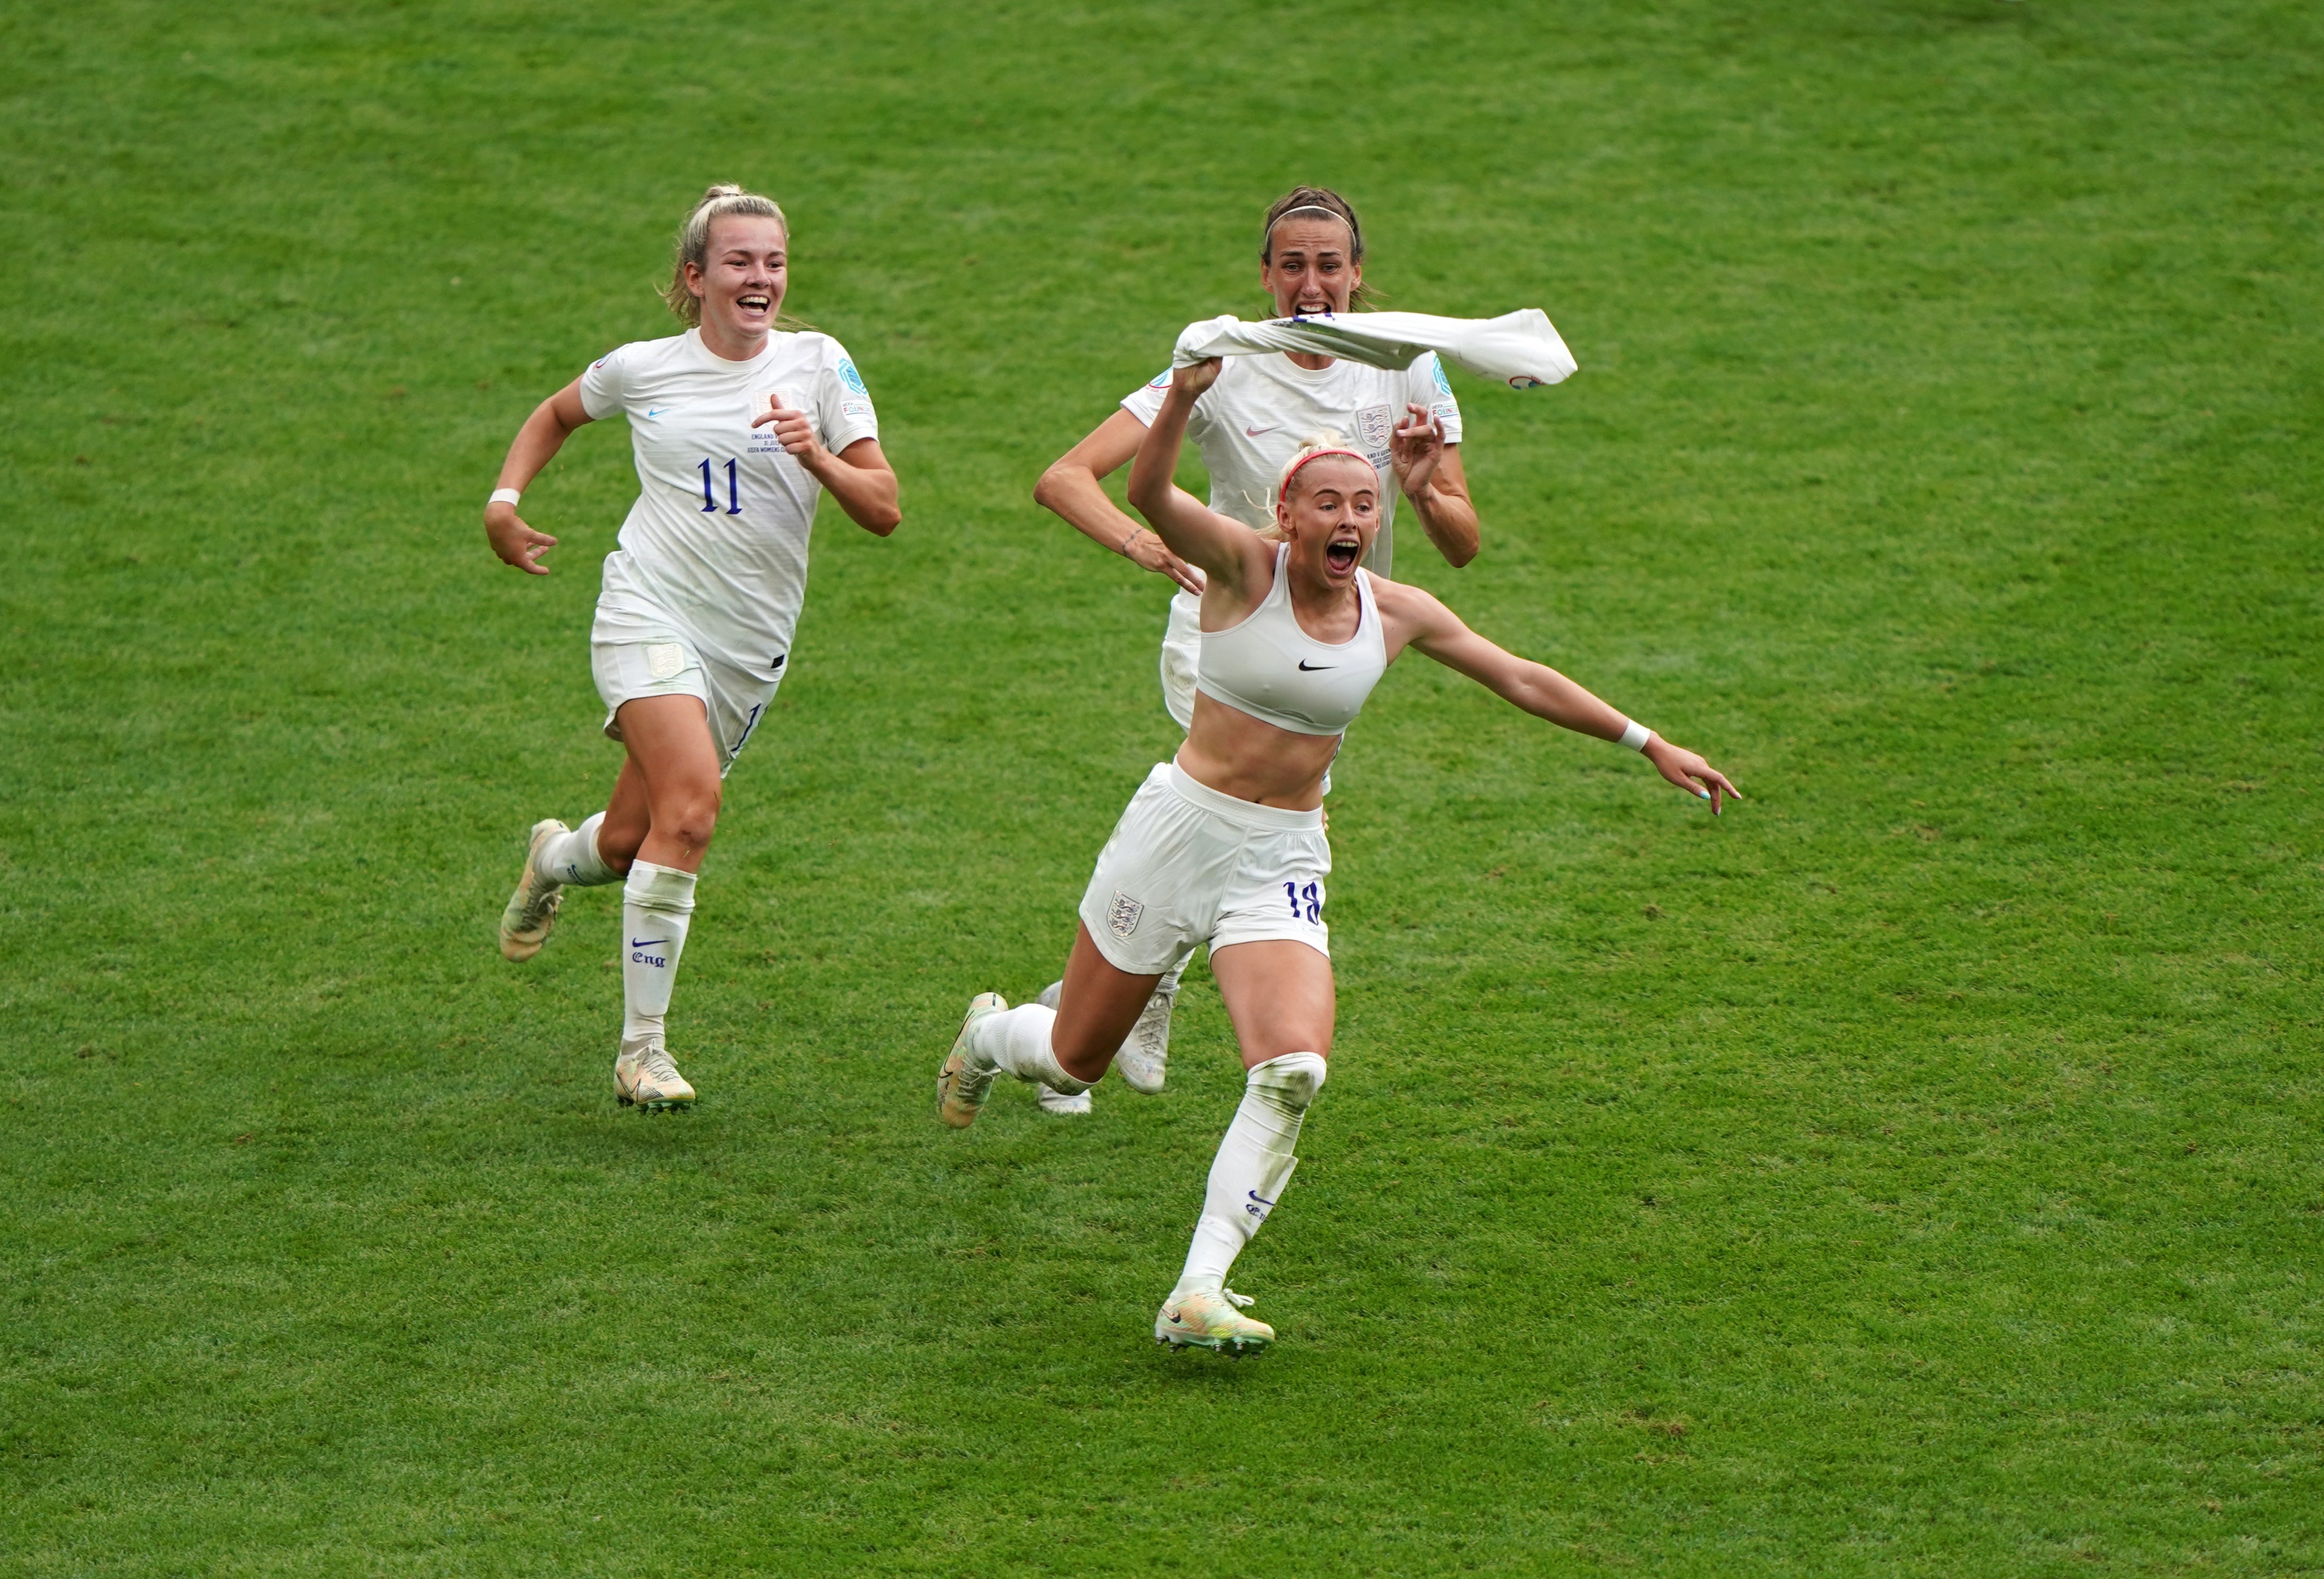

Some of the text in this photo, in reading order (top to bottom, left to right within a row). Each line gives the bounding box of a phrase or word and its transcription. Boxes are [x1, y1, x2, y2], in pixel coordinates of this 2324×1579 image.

[698, 457, 743, 514] 11
[1283, 881, 1320, 926] 18
[632, 951, 666, 968] Eng
